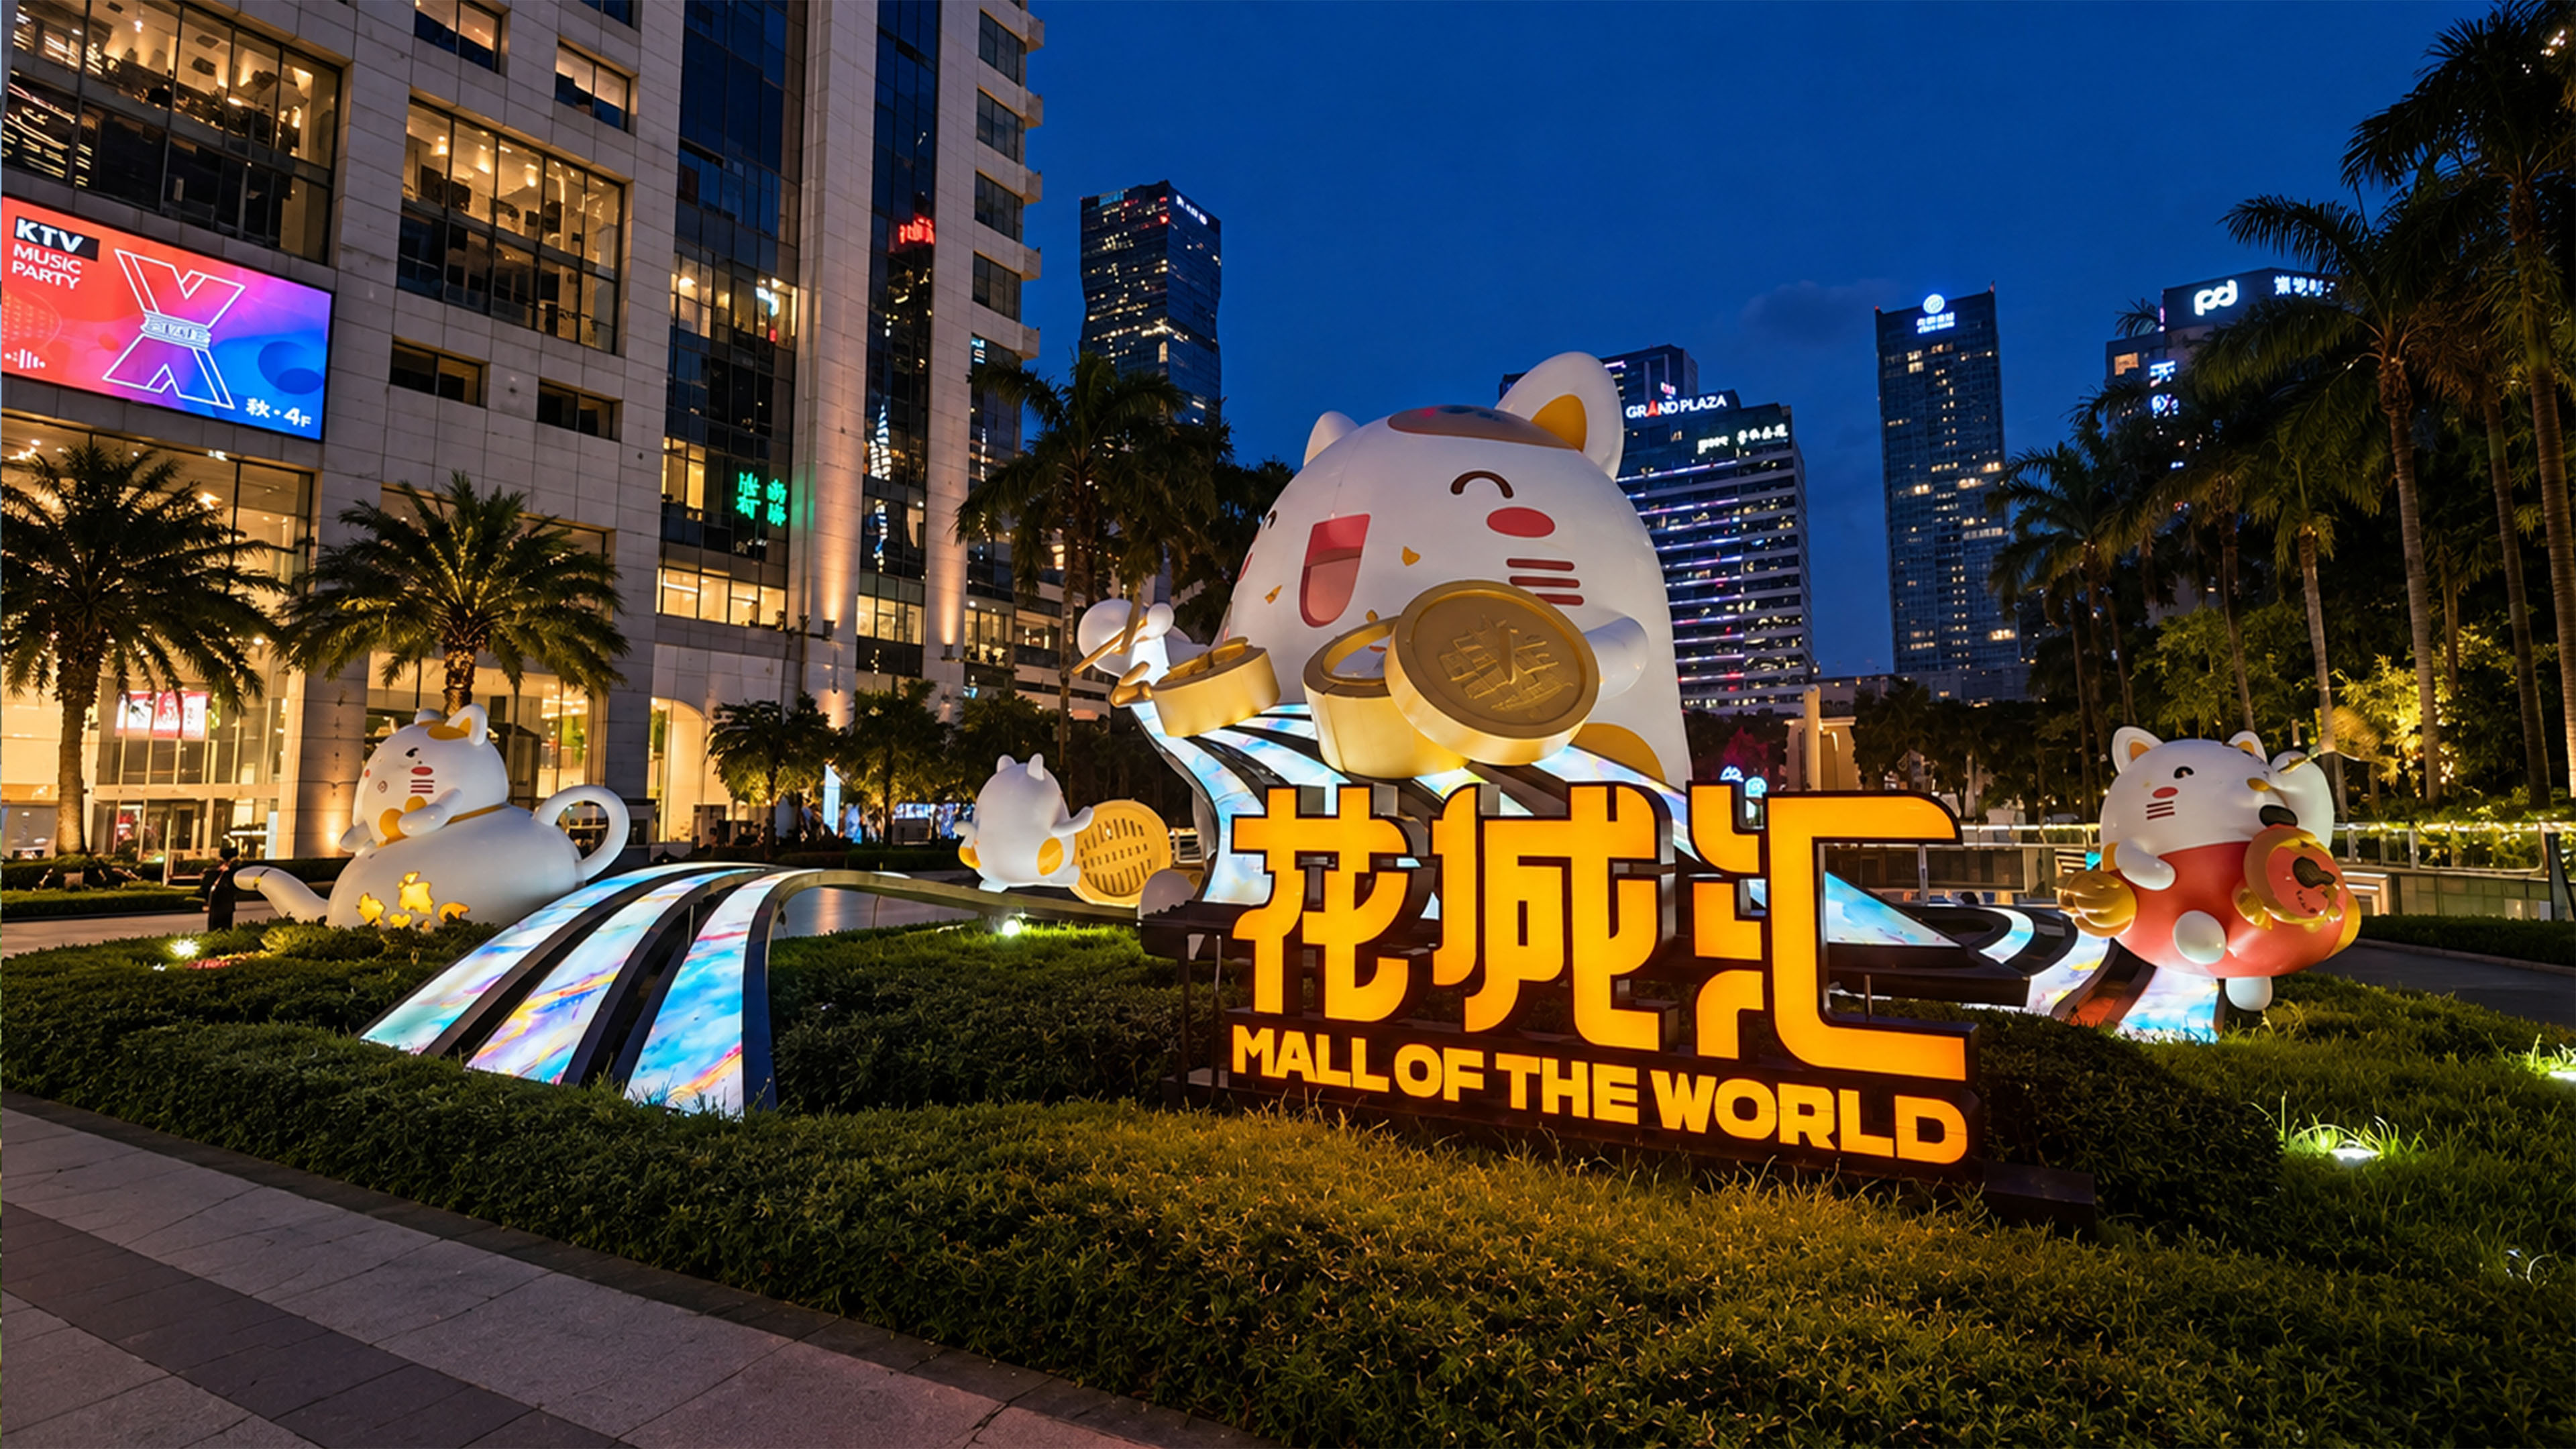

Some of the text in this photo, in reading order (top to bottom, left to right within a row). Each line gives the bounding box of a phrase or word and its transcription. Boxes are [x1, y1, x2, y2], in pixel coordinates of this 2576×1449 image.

[15, 218, 84, 253] KTV
[11, 260, 80, 290] PARTY
[13, 243, 82, 274] MUSIC
[1625, 394, 1727, 419] GRAND PLAZA
[1231, 784, 1968, 1081] 花城汇
[1232, 1023, 1969, 1165] MALL OF THE WORLD
